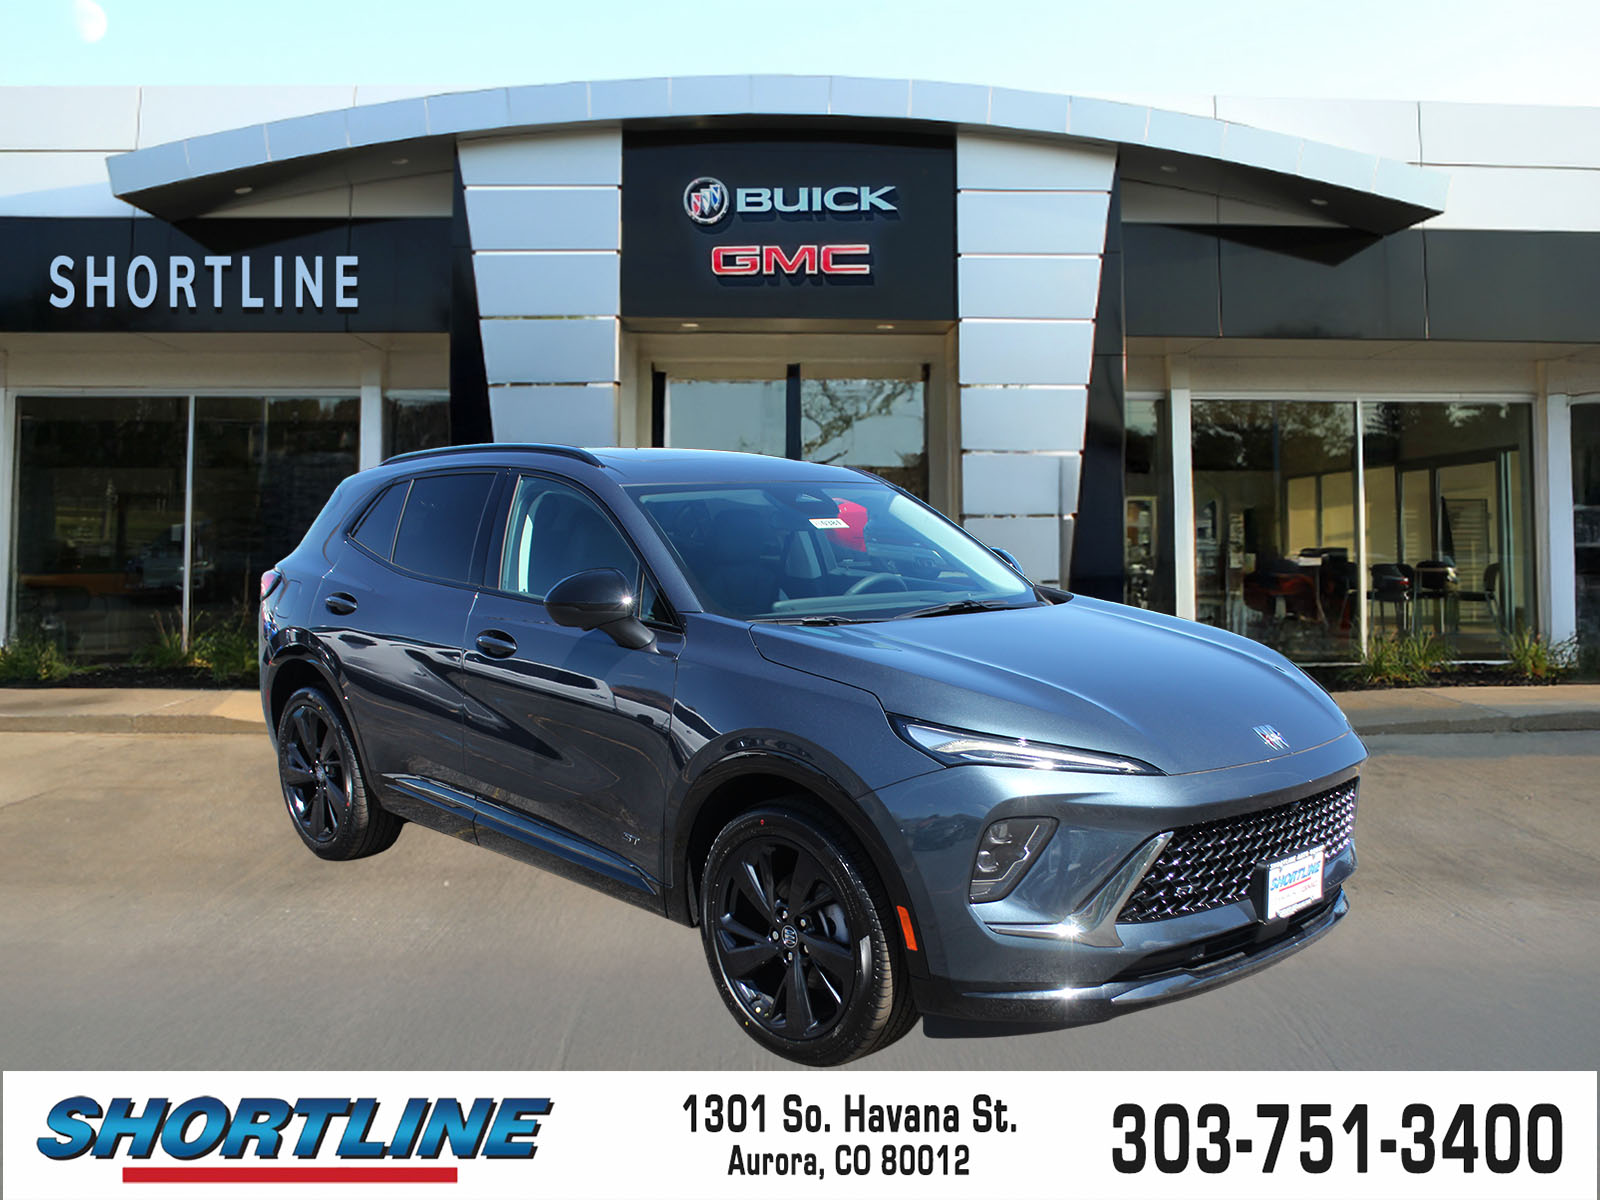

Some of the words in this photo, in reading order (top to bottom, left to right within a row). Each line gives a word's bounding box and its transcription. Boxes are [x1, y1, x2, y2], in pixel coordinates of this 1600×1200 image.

[736, 186, 898, 212] BUICK
[711, 244, 871, 275] GMC
[49, 255, 360, 309] SHORTLINE
[623, 831, 640, 846] ST
[1270, 861, 1321, 891] SHORTLINE
